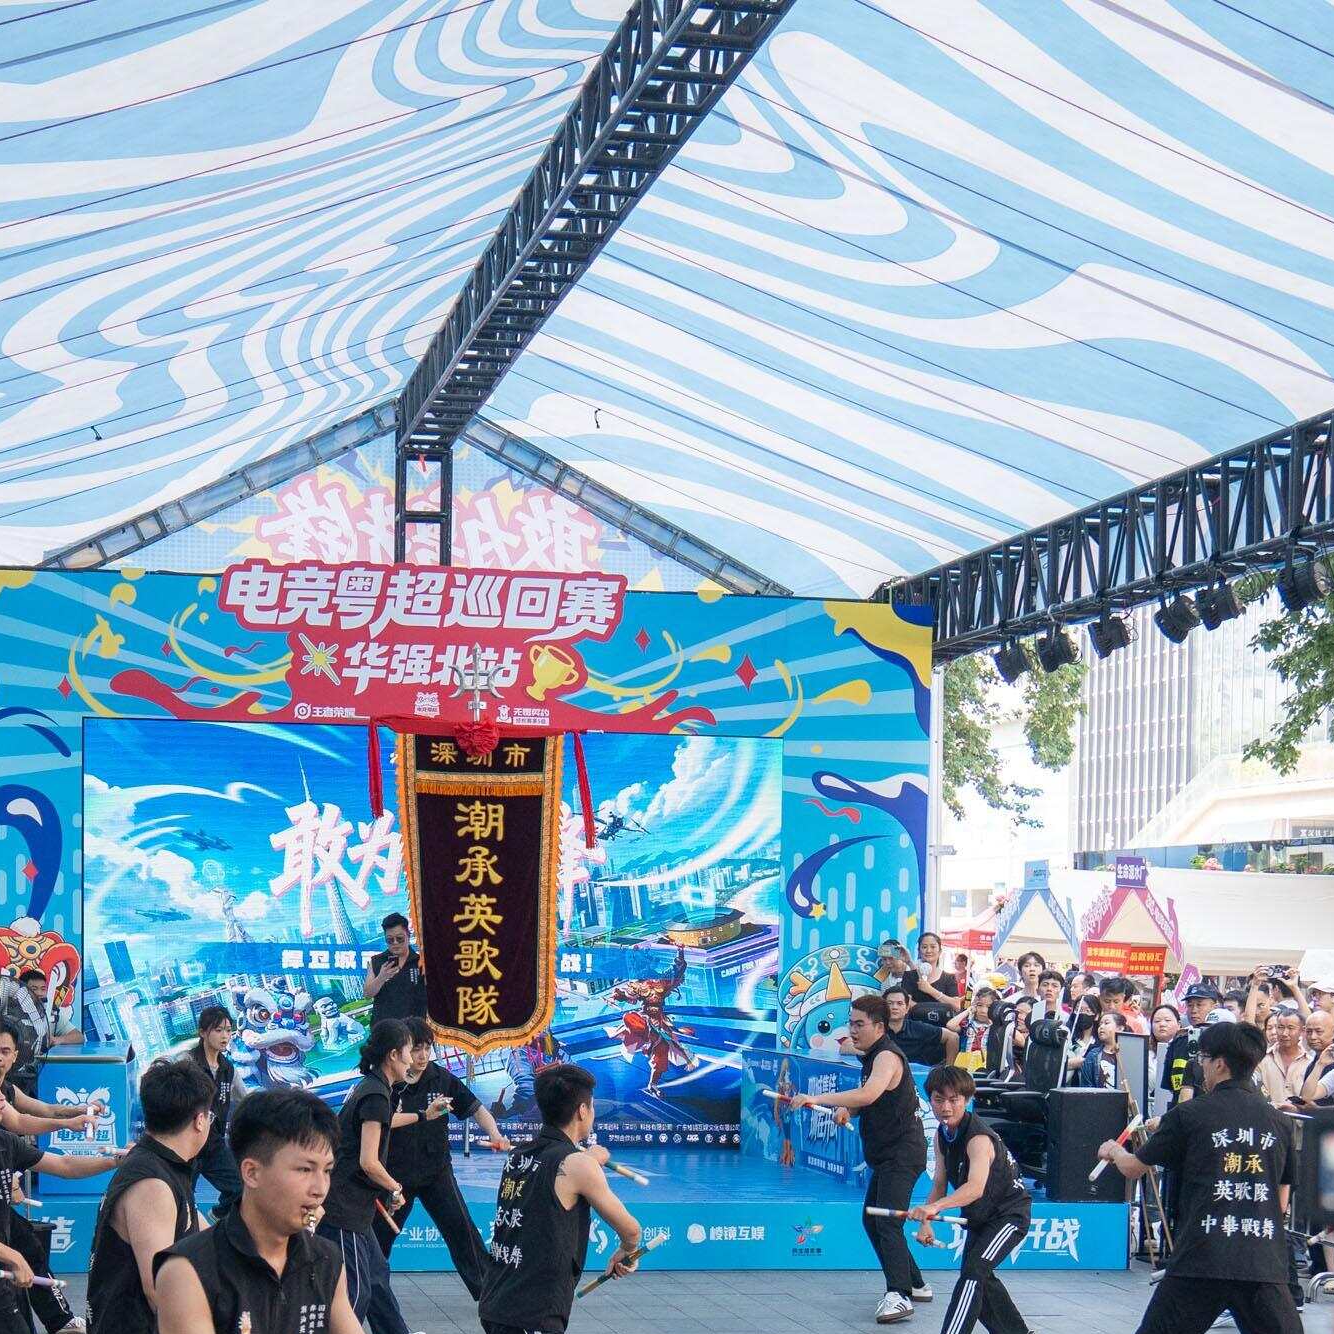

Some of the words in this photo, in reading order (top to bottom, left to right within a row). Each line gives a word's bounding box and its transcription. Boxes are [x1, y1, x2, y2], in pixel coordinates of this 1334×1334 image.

[225, 563, 620, 640] 电竞粤超巡回赛
[342, 641, 523, 696] 华强北站
[453, 800, 505, 1025] 潮承英歌隊
[57, 1128, 111, 1142] 电竞超
[1211, 1127, 1277, 1151] 深圳市
[1223, 1152, 1264, 1174] 潮承
[710, 1226, 765, 1241] 棱镜互娱
